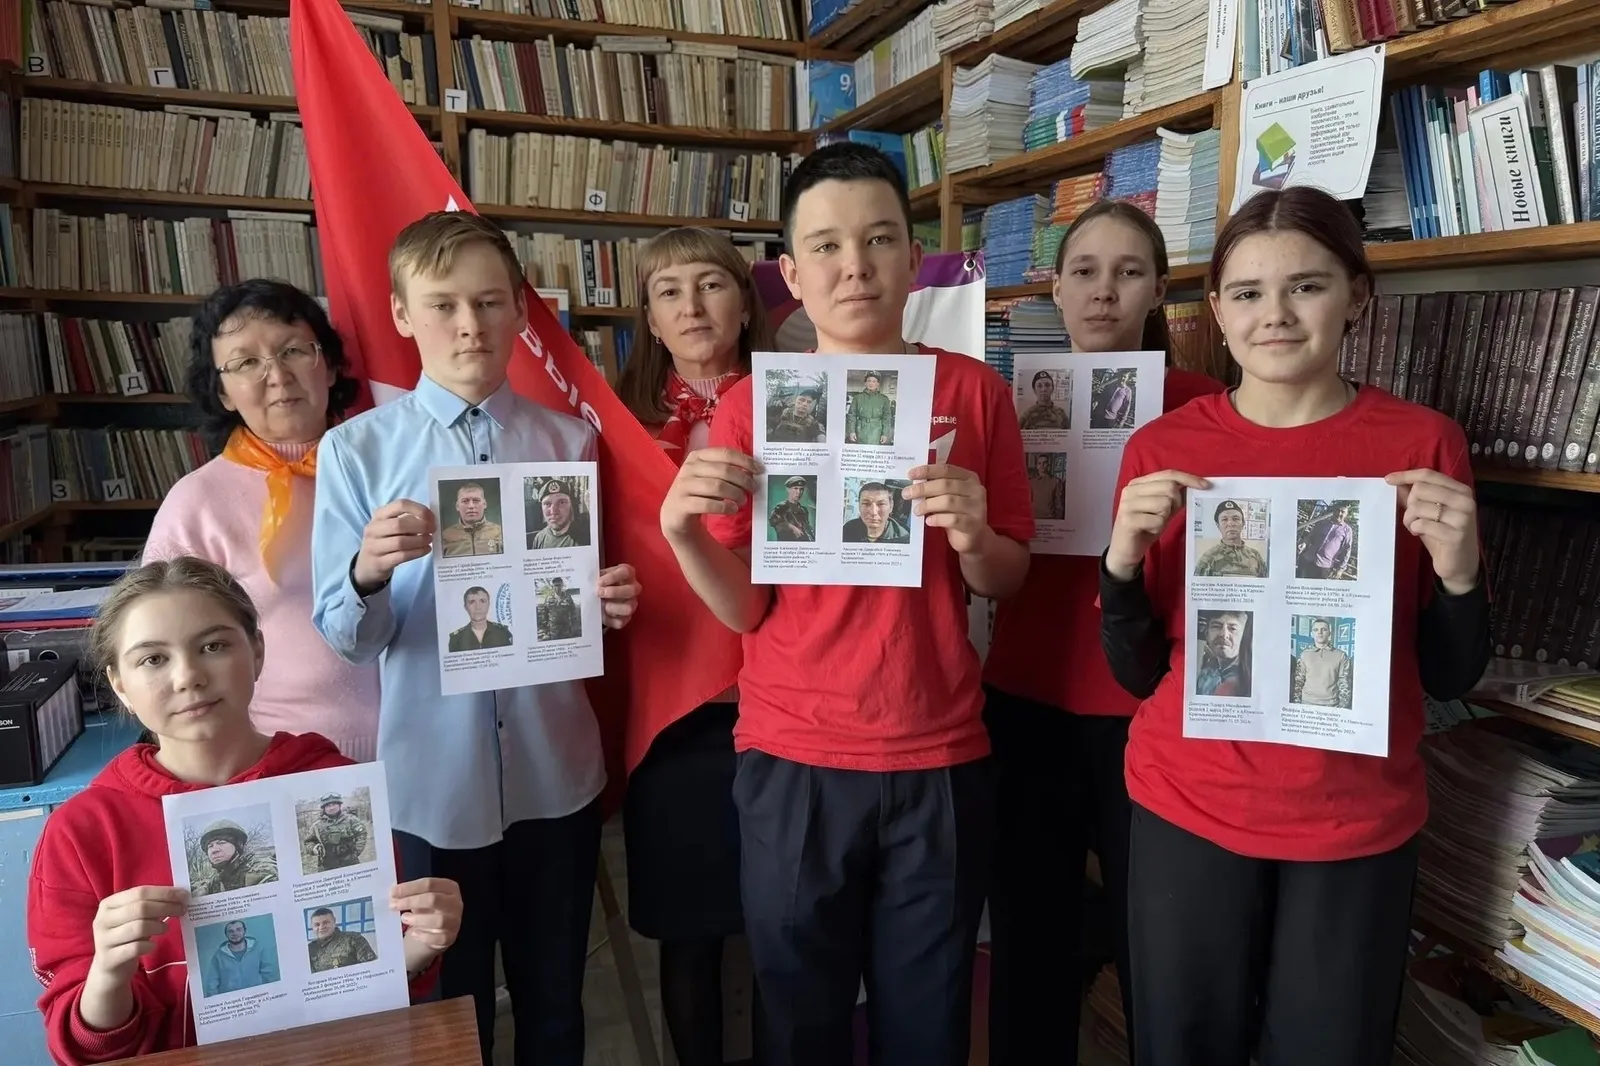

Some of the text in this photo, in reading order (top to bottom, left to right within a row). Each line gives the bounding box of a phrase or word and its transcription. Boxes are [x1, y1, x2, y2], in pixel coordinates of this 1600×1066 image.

[28, 56, 44, 72] В
[154, 70, 169, 85] Г
[446, 95, 461, 110] Т
[1254, 100, 1273, 110] Книги
[1278, 95, 1297, 105] наши
[1297, 86, 1324, 102] друзья!
[1499, 115, 1531, 223] Новые книги
[589, 193, 603, 206] Ф
[733, 203, 745, 219] Ч
[598, 290, 611, 305] Ш
[127, 376, 143, 391] Д
[1553, 389, 1565, 414] Гоголь
[53, 484, 67, 498] З
[107, 483, 122, 497] И
